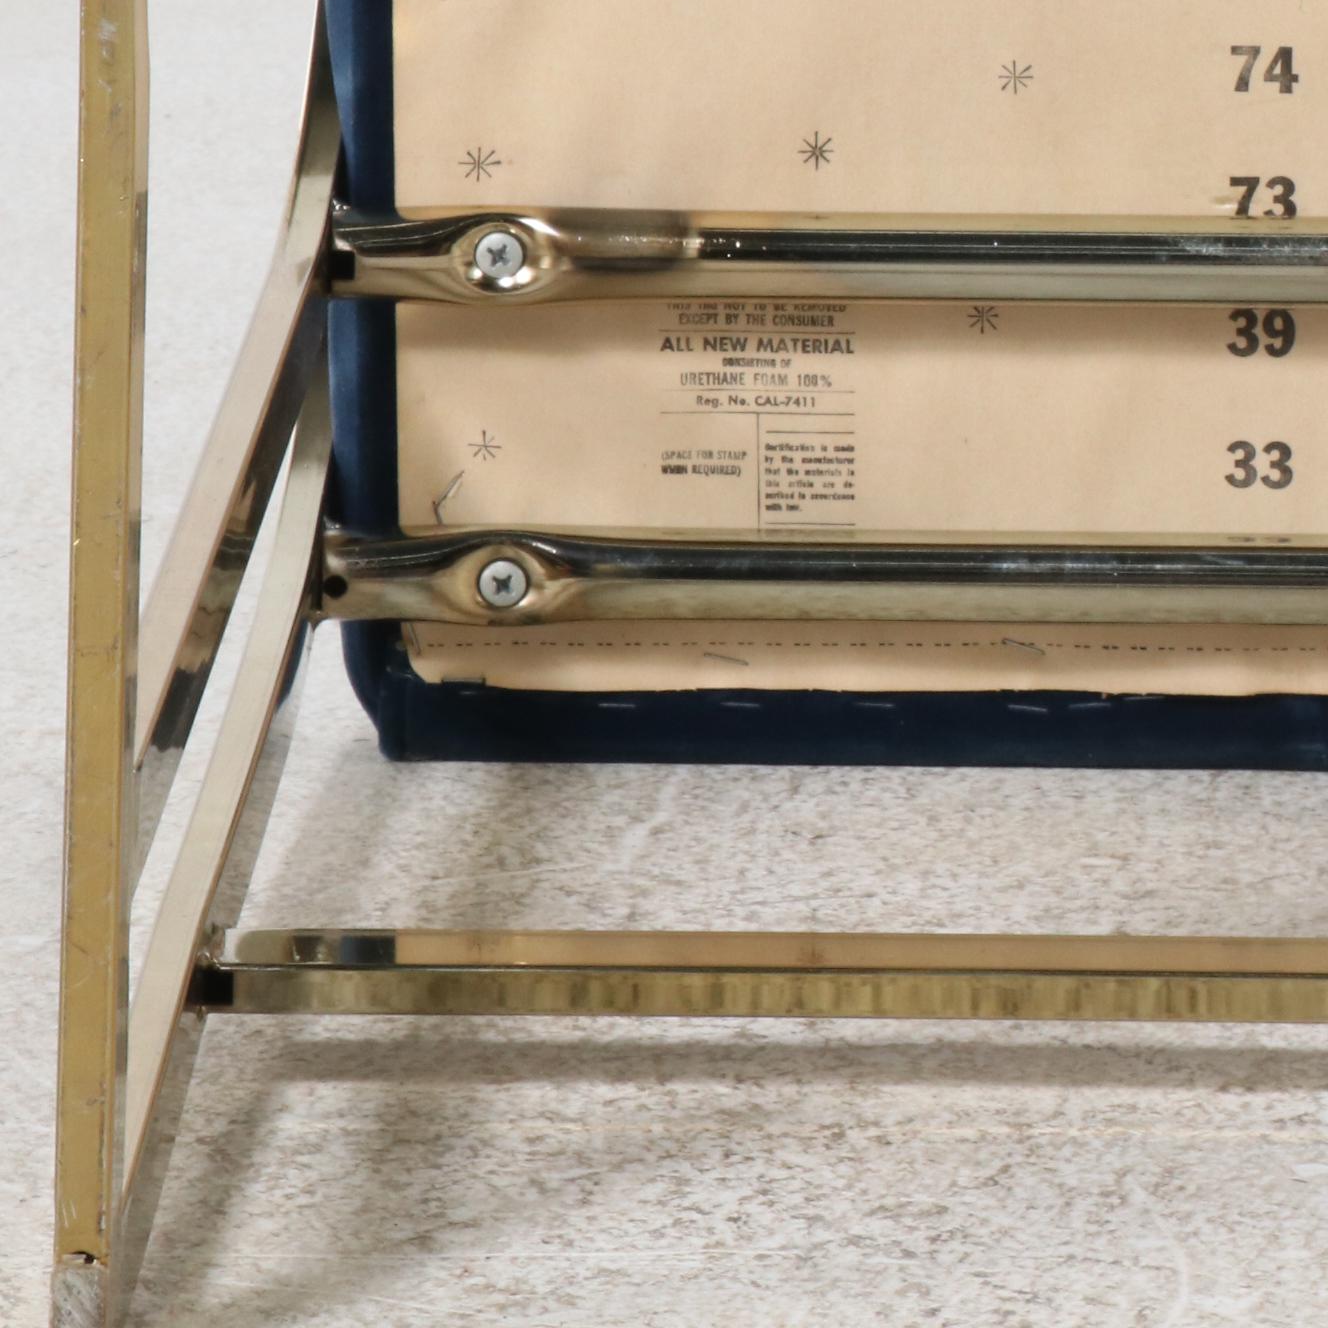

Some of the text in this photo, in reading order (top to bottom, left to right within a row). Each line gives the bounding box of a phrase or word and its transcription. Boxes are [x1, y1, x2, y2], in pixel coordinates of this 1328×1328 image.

[1231, 45, 1299, 94] 74
[1229, 176, 1297, 218] 73
[679, 313, 835, 327] EXCEPT BY THE CONSUMER
[1226, 308, 1296, 358] 39
[660, 337, 855, 354] ALL NEW MATERIAL
[722, 358, 792, 368] CONSISTING OF
[680, 373, 832, 387] URETHANE FOAM 100%
[696, 395, 816, 408] Reg. No. CAL-7411
[1224, 440, 1294, 490] 33
